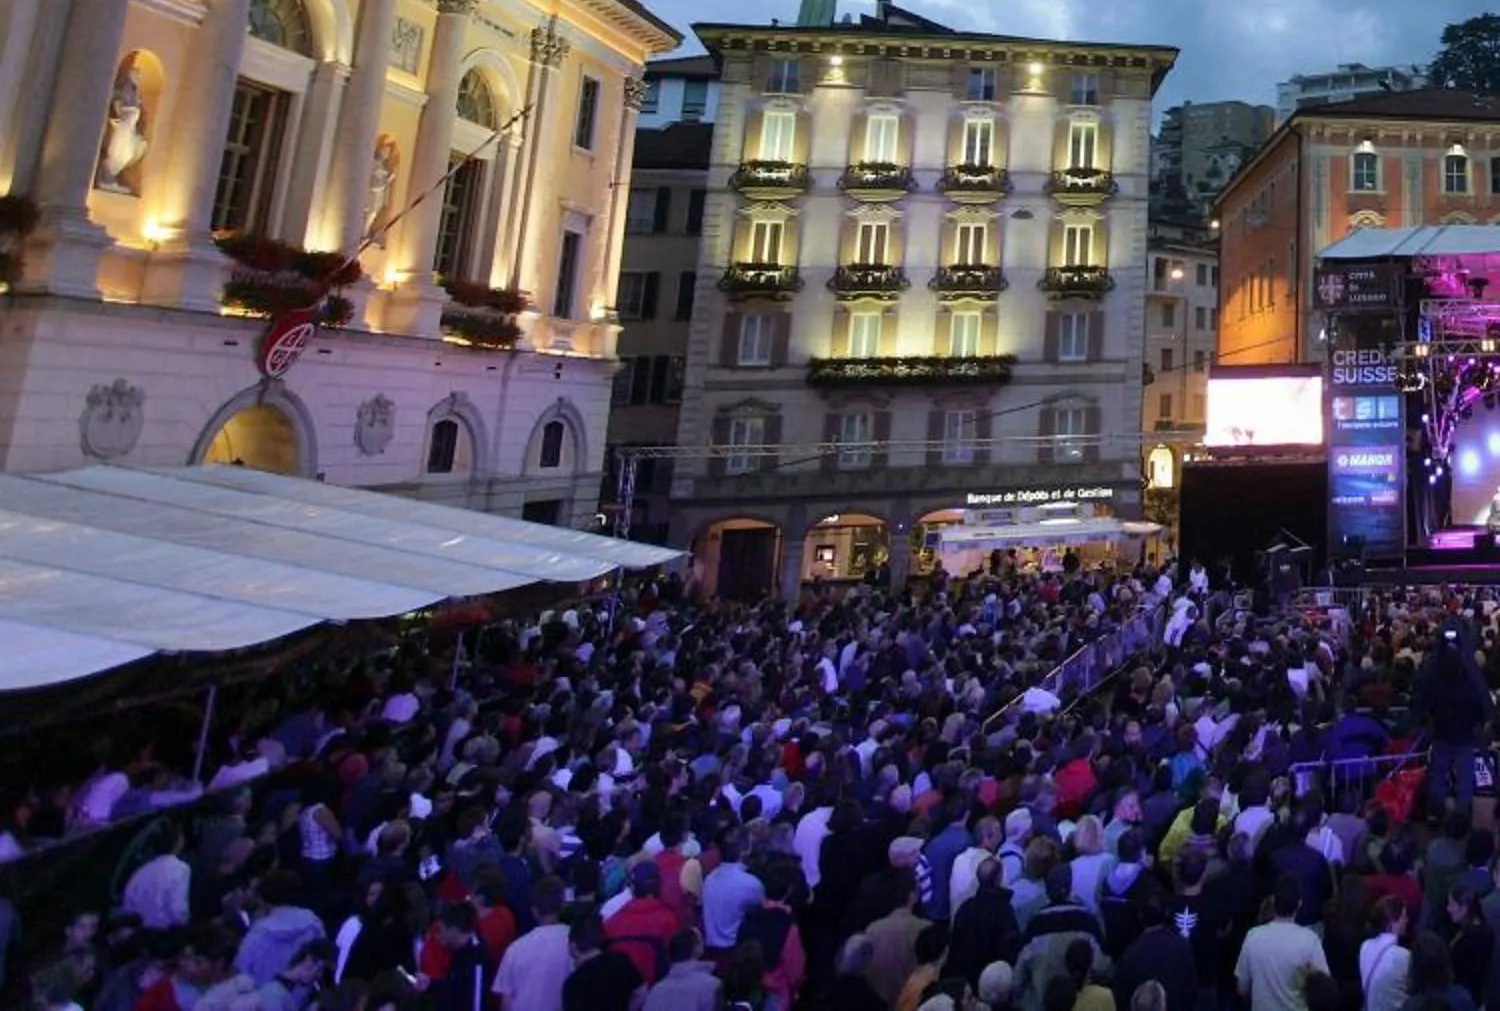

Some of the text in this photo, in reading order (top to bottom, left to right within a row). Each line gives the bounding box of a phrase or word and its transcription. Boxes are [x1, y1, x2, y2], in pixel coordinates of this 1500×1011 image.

[1332, 350, 1396, 366] CRED
[1332, 366, 1398, 384] SUISSE
[966, 492, 1002, 505] Banque
